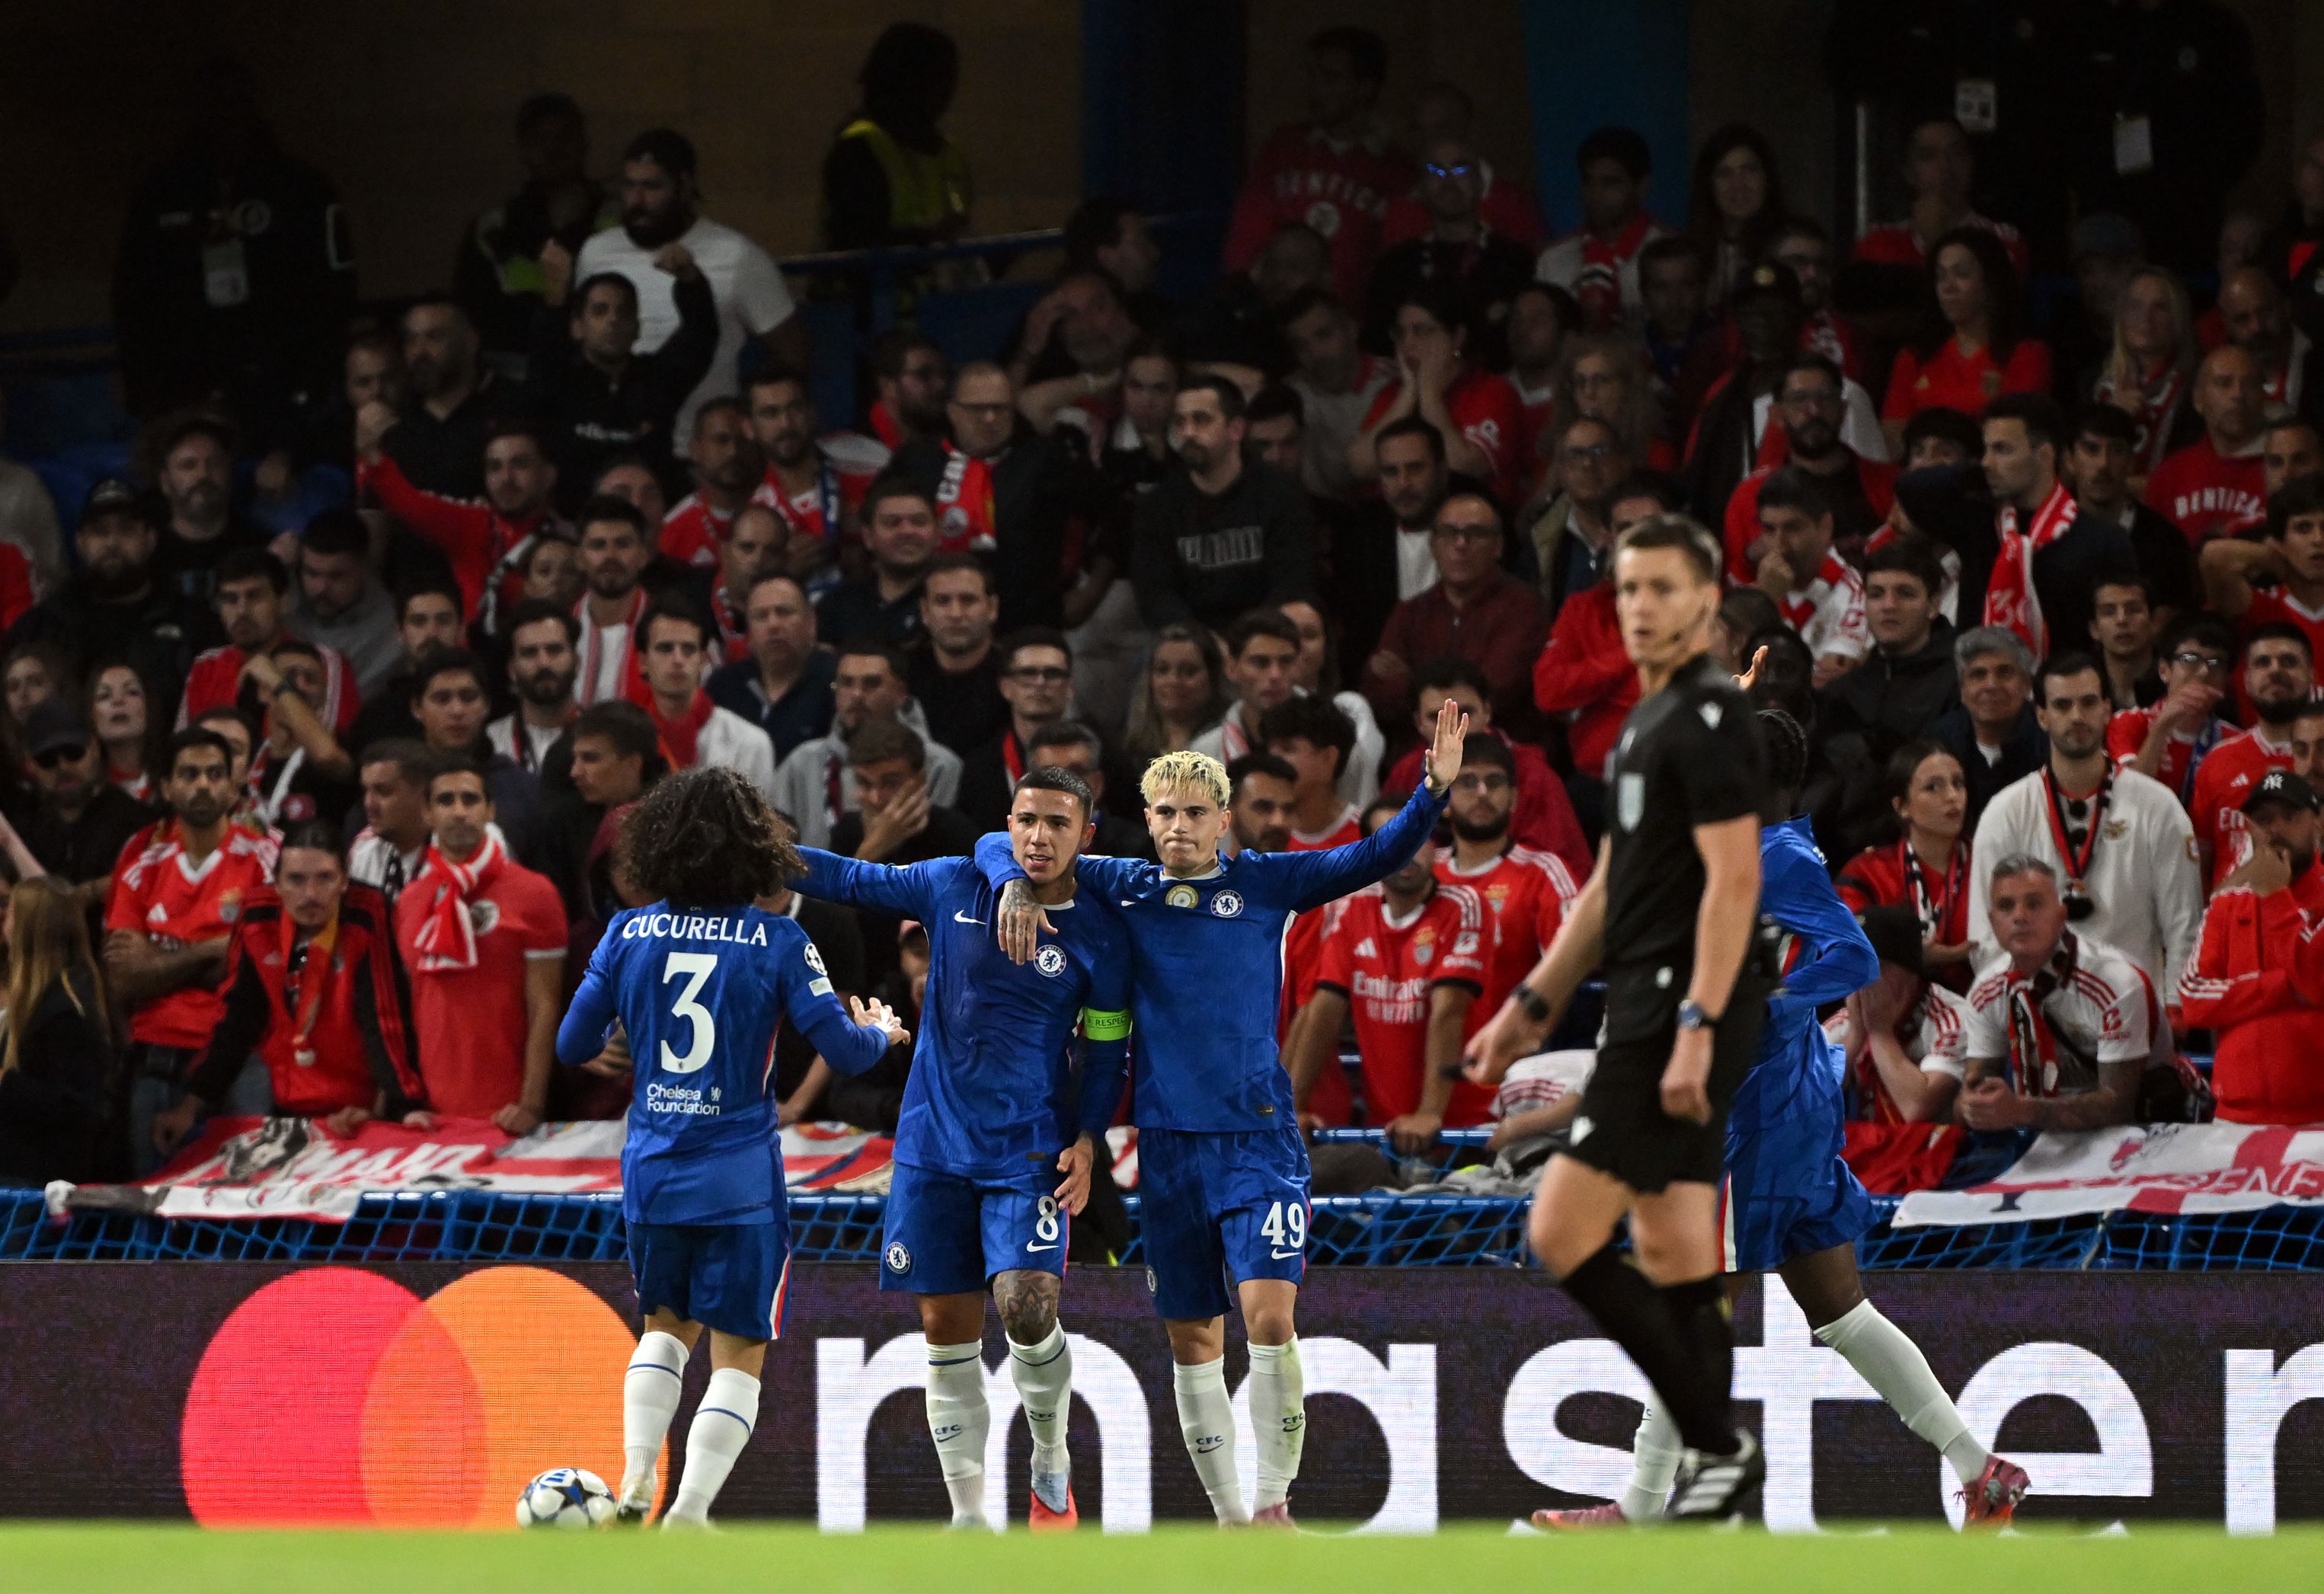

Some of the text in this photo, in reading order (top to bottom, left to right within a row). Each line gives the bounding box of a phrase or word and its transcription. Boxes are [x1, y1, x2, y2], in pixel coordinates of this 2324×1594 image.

[622, 913, 767, 947] CUCURELLA
[660, 952, 718, 1074] 3
[647, 1084, 702, 1100] Chelsea
[647, 1097, 720, 1116] Foundation
[1037, 1196, 1059, 1241] 8
[1261, 1201, 1305, 1248] 49
[1282, 1413, 1303, 1424] CFC
[935, 1424, 962, 1435] CFC
[1196, 1435, 1223, 1445] CFC
